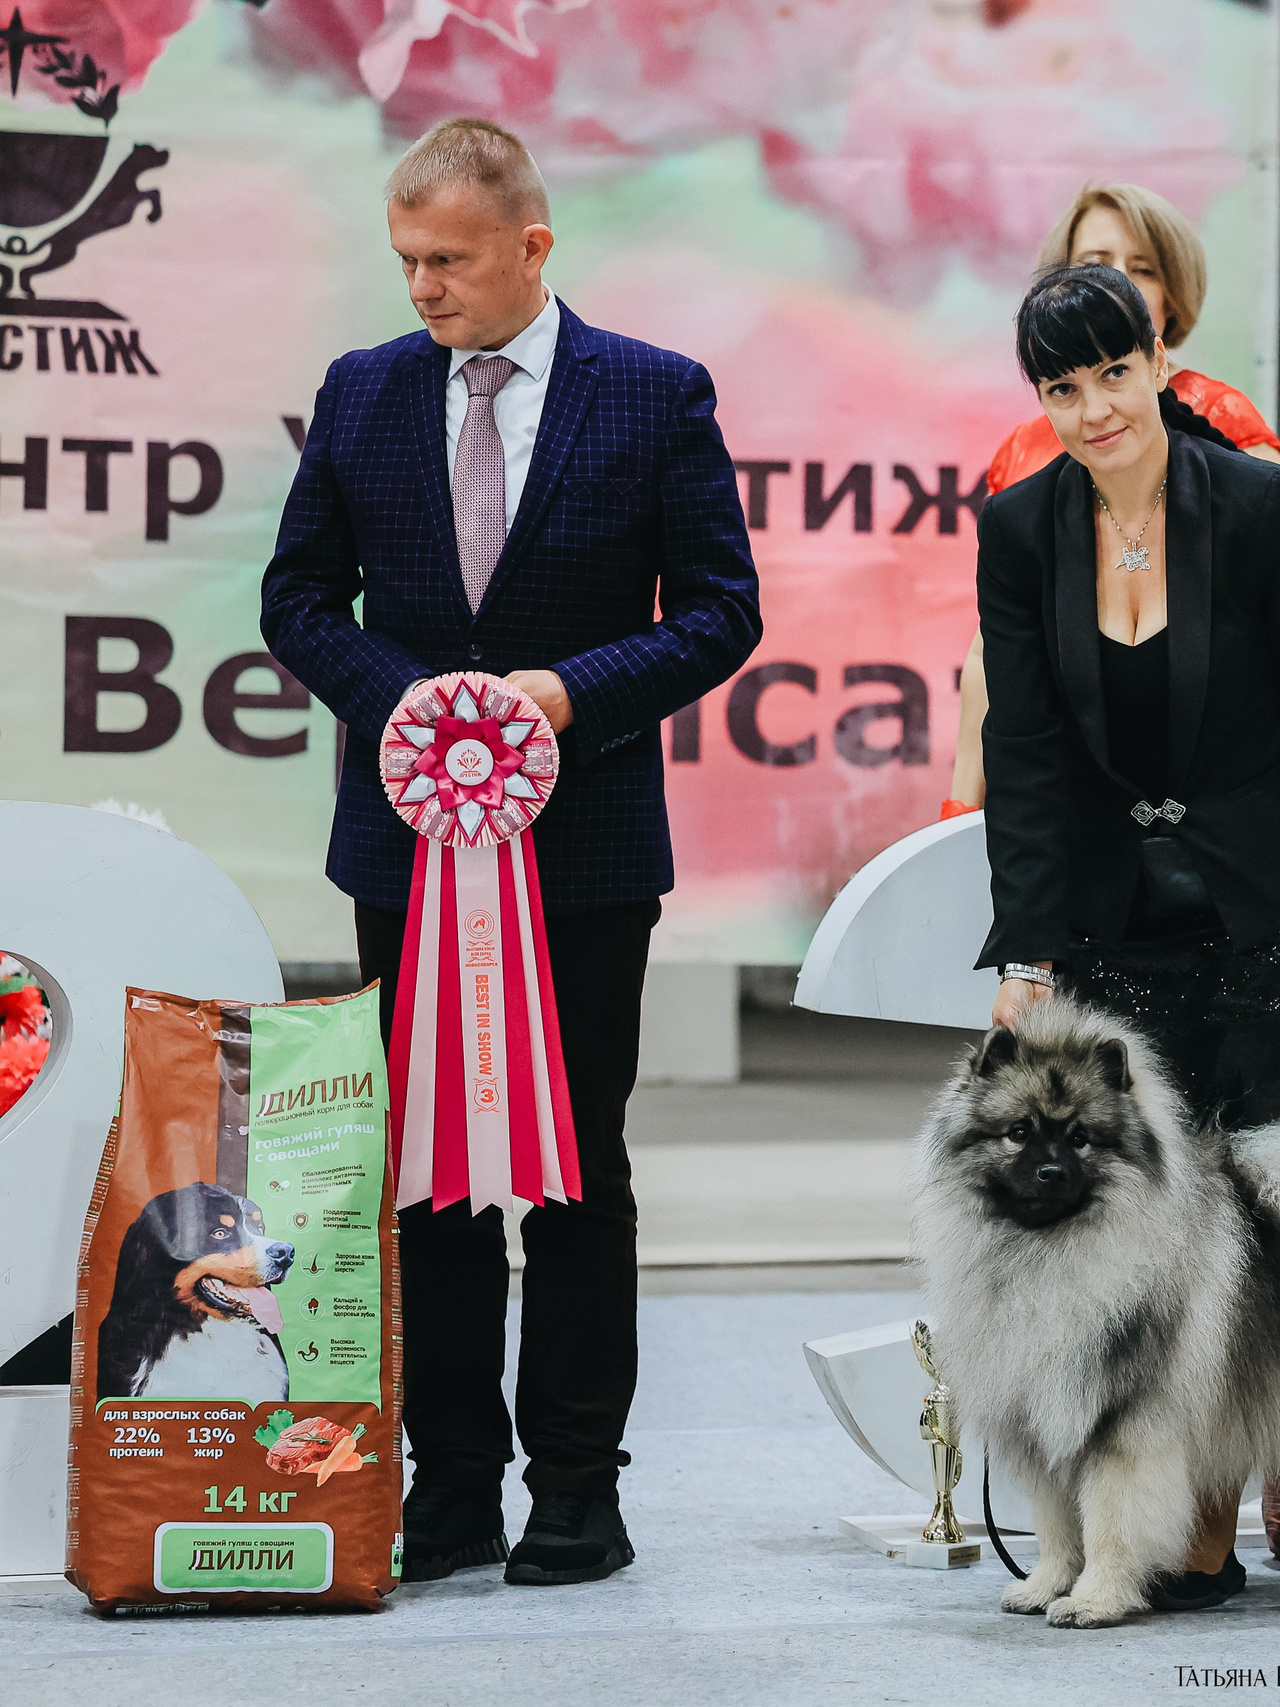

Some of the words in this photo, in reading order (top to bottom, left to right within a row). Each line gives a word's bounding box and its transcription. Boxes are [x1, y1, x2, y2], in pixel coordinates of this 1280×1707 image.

[0, 324, 160, 376] СТИЖ
[0, 436, 224, 541] нтр
[733, 461, 989, 535] тиж
[476, 975, 490, 1010] BEST
[477, 1014, 490, 1028] IN
[478, 1032, 492, 1075] SHOW
[256, 1072, 373, 1118] ДИЛЛИ
[480, 1088, 494, 1103] 3
[254, 1108, 316, 1127] полнорационный
[316, 1106, 336, 1116] корм
[337, 1103, 351, 1112] для
[352, 1101, 374, 1109] собак
[255, 1127, 323, 1150] говяжий
[327, 1124, 375, 1138] гуляш
[254, 1153, 264, 1163] с
[267, 1141, 340, 1161] овощами
[103, 1409, 129, 1422] для
[132, 1409, 201, 1422] взрослых
[203, 1408, 247, 1421] собак
[113, 1426, 161, 1445] 22%
[186, 1426, 236, 1445] 13%
[109, 1448, 164, 1460] протеин
[193, 1448, 224, 1460] жир
[203, 1485, 248, 1514] 14
[258, 1491, 298, 1514] кг
[193, 1539, 227, 1547] говяжий
[188, 1549, 294, 1571] ДИЛЛИ
